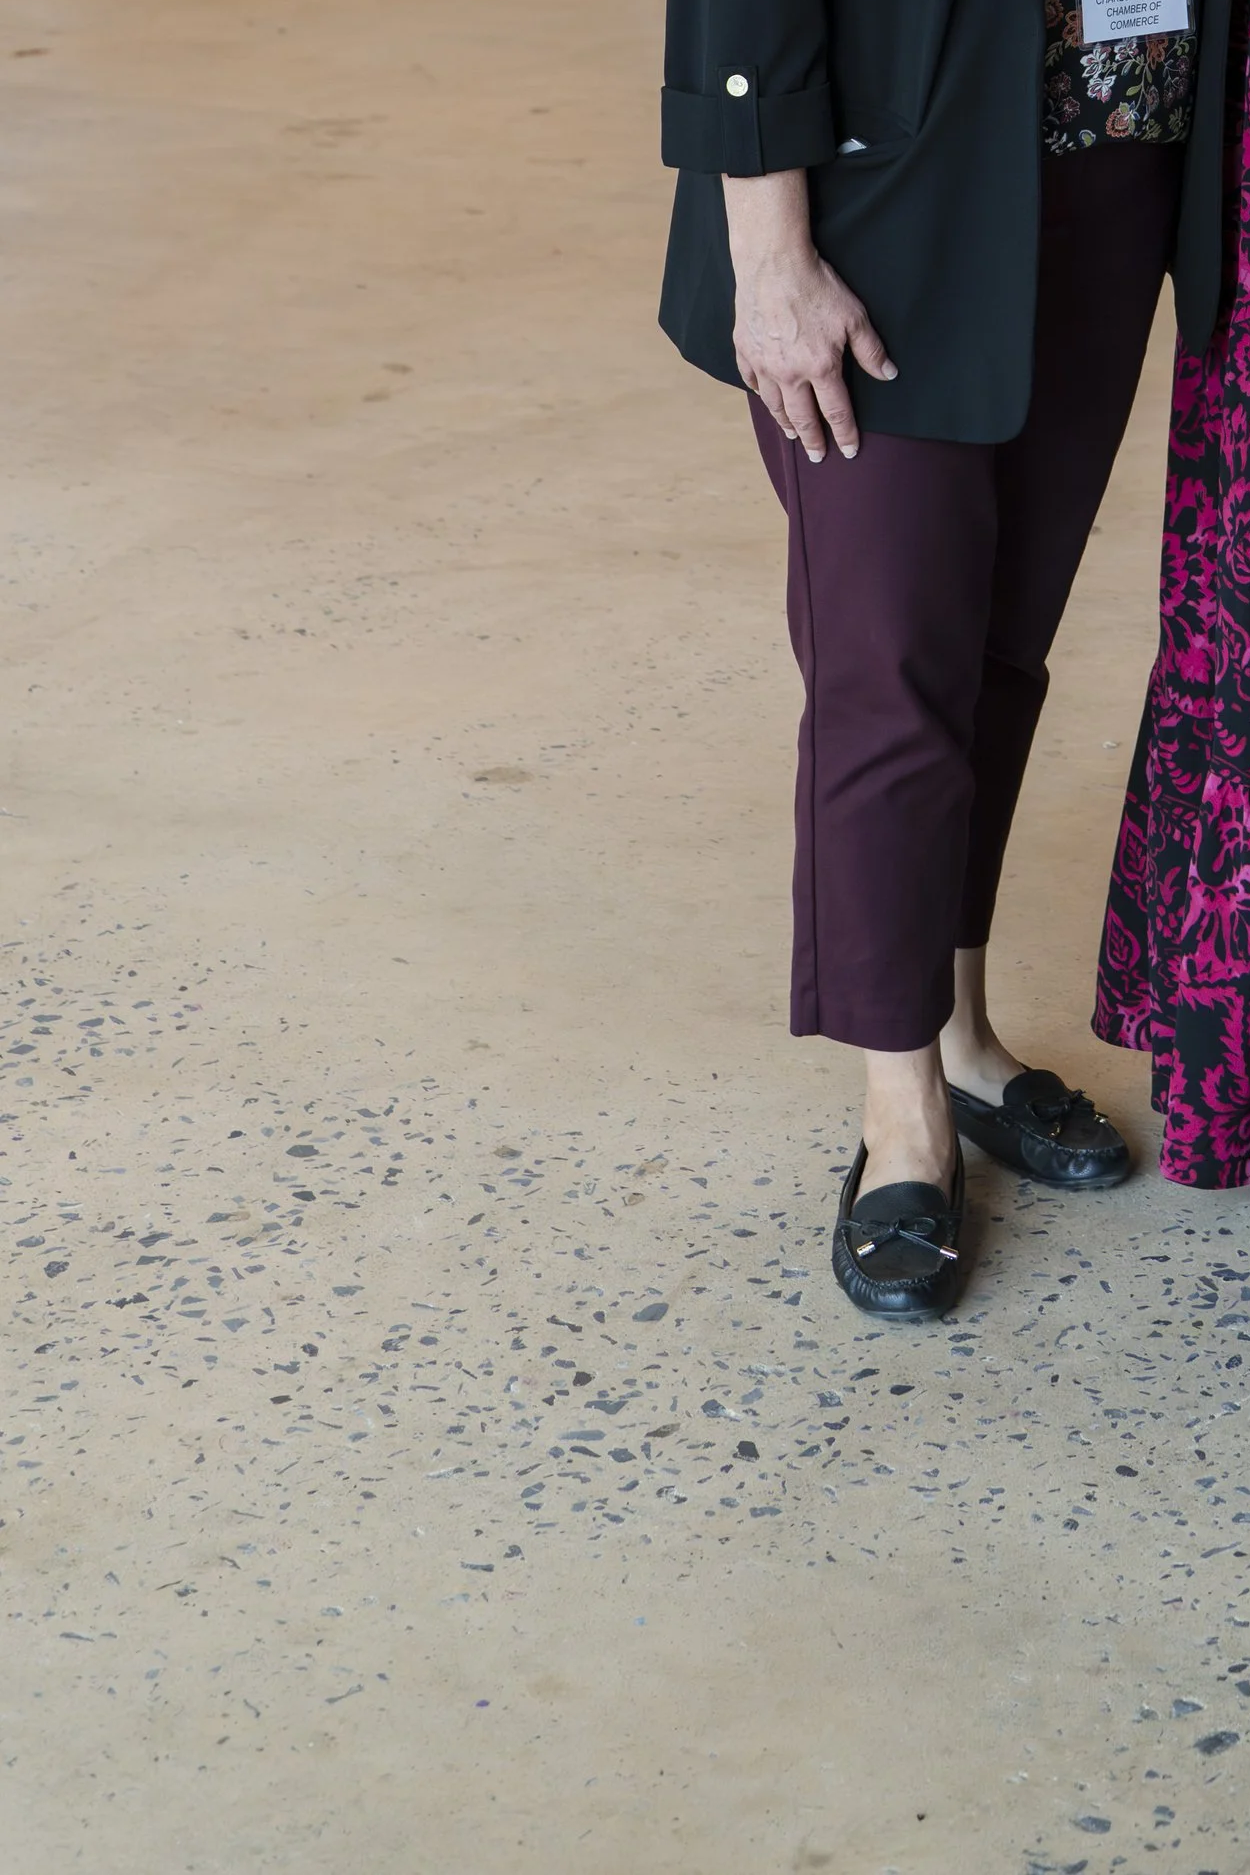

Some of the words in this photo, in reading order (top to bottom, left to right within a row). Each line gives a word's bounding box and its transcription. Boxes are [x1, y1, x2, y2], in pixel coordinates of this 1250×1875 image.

[1106, 3, 1148, 17] CHAMBER
[1149, 1, 1162, 11] OF
[1110, 15, 1159, 30] COMMERCE
